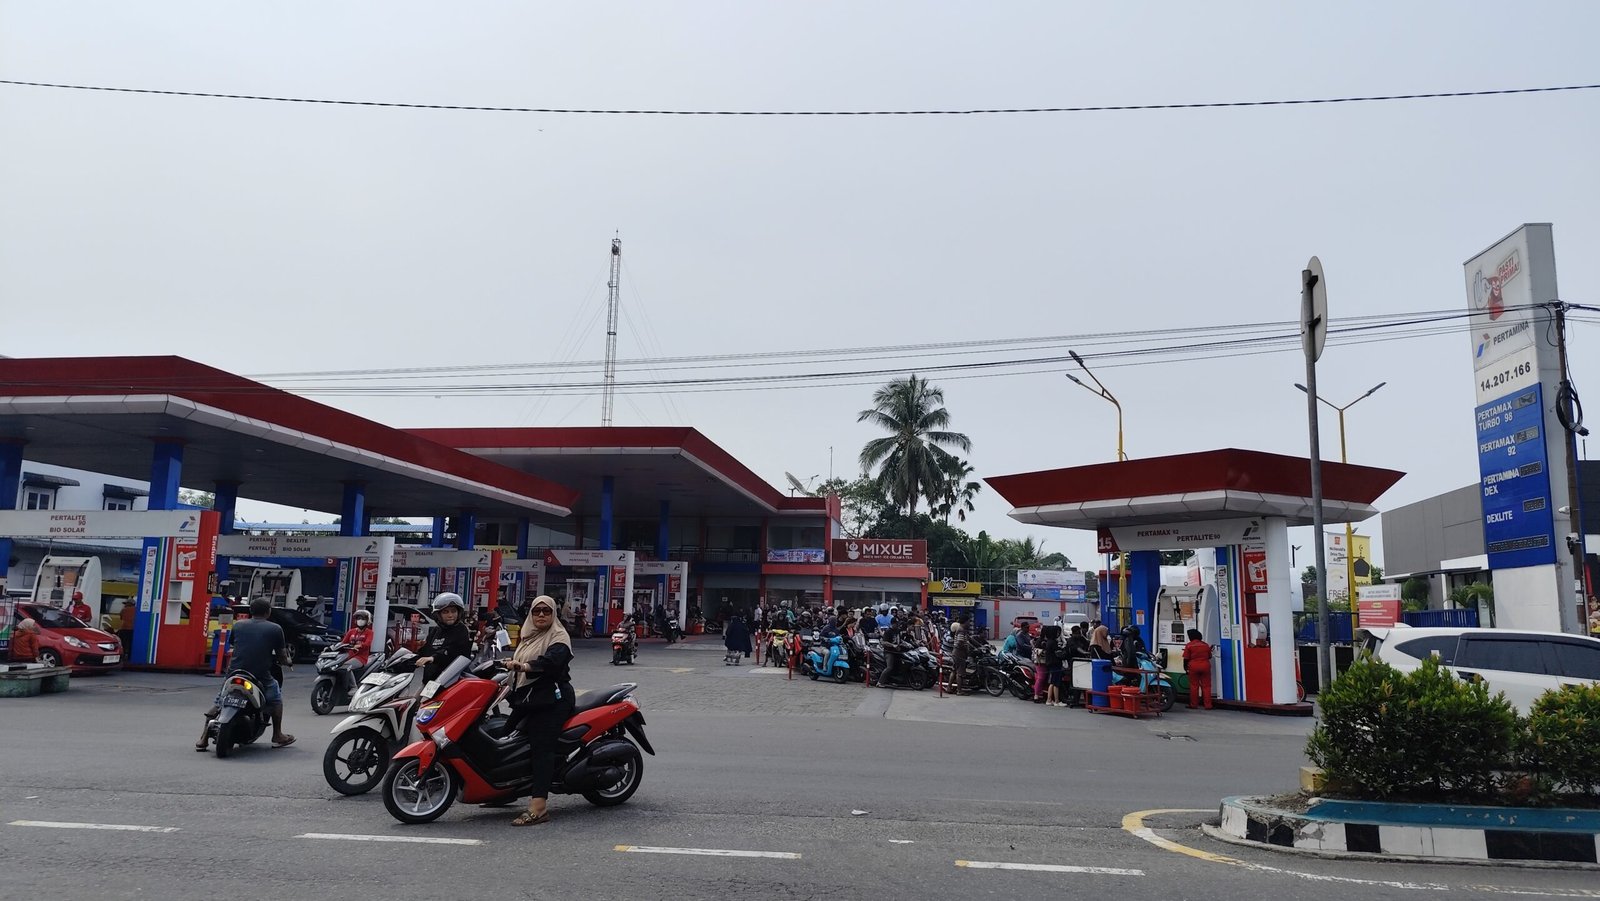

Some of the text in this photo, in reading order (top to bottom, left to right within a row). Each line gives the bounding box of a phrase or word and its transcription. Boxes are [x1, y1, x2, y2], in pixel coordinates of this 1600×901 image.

[1493, 320, 1529, 345] PERTAMINA
[1480, 361, 1531, 391] 14.207.166
[1477, 400, 1513, 421] PERTAMAX
[1478, 411, 1513, 431] TURBO 98
[1480, 434, 1516, 454] PERTAMAX
[1507, 445, 1517, 456] 92
[1483, 467, 1520, 486] PERTAMINA
[1484, 484, 1499, 497] DEX
[1486, 510, 1513, 524] DEXLITE
[1137, 529, 1171, 537] PERTAMAX
[1176, 533, 1214, 542] PERTALITE
[862, 543, 913, 556] MIXUE
[1098, 537, 1113, 550] 15
[499, 572, 515, 581] KI
[1328, 589, 1347, 598] FREE
